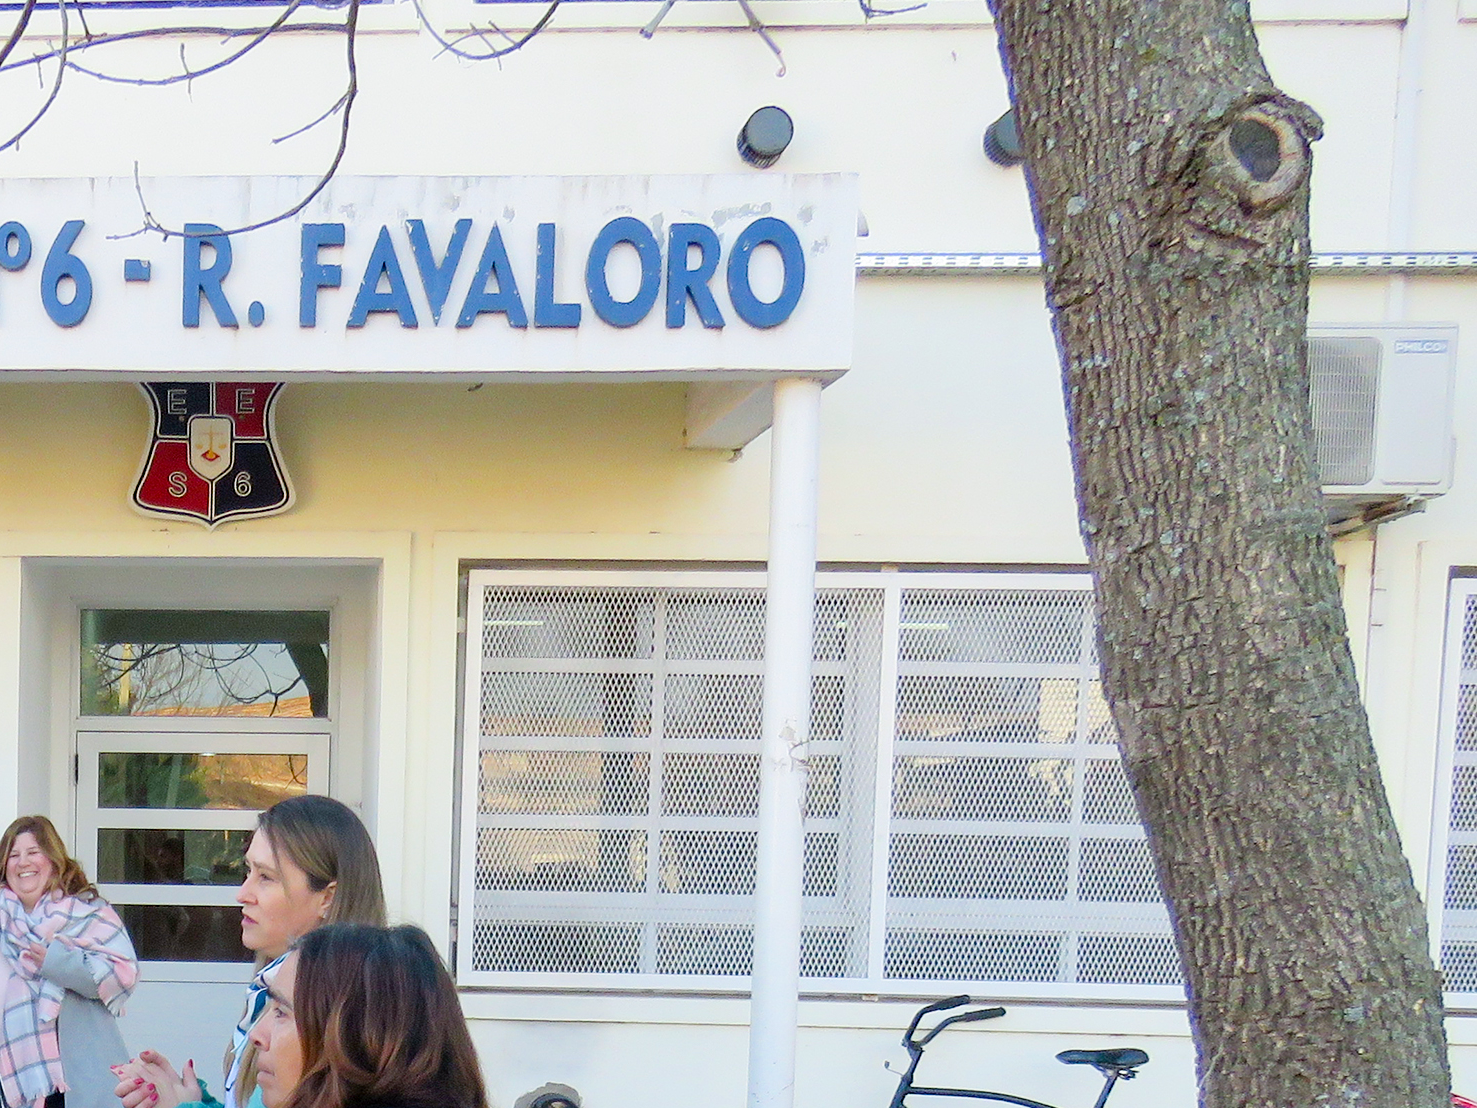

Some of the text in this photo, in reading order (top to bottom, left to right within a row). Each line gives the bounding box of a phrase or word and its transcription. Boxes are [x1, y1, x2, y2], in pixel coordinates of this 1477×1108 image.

[182, 221, 265, 330] R.
[298, 216, 806, 331] FAVALORO
[1395, 341, 1442, 353] PHILCO
[168, 471, 252, 498] S 6
